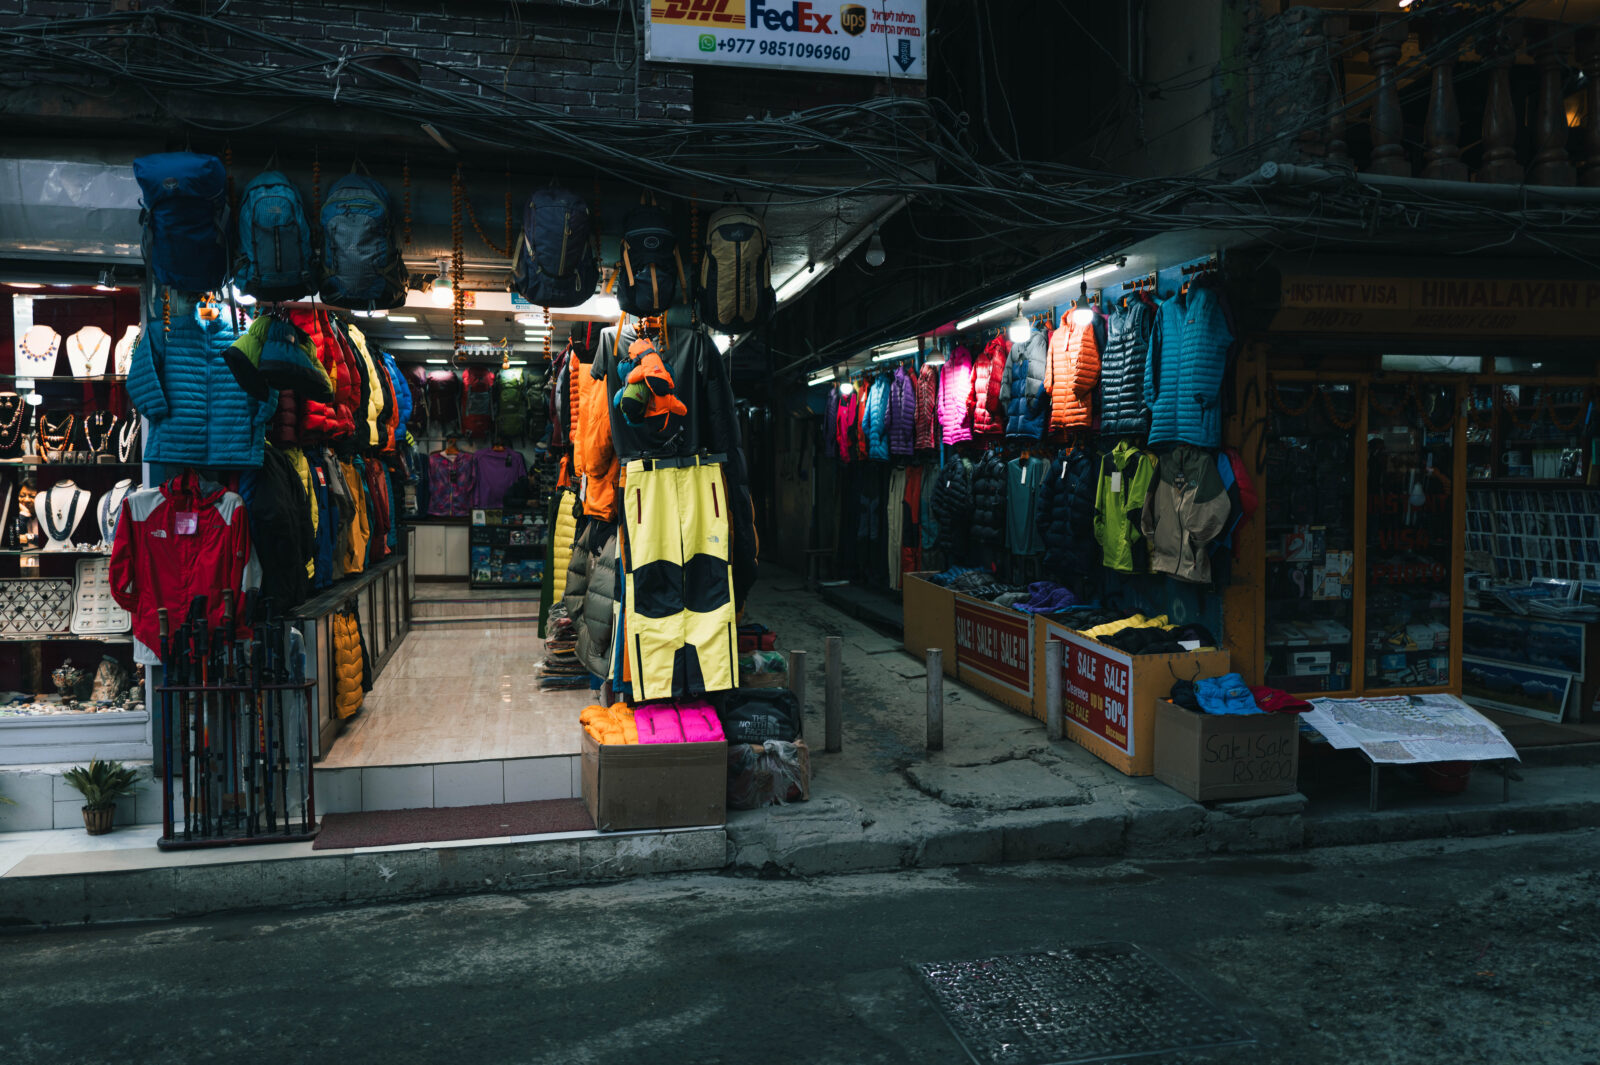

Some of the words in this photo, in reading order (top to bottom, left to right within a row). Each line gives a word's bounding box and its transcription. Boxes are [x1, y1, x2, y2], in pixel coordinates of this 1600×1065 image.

[664, 0, 733, 23] DHL
[842, 14, 865, 31] ups
[717, 37, 755, 54] +977
[759, 40, 851, 61] 9851096960
[1289, 282, 1356, 302] INSTANT
[1360, 284, 1398, 304] VISA
[1421, 280, 1578, 308] HIMALAYAN
[1303, 311, 1364, 328] PHOTO
[1378, 528, 1429, 551] VISA
[1371, 562, 1445, 584] PHOTO
[1077, 650, 1096, 682] SALE
[1104, 663, 1127, 696] SALE
[752, 714, 768, 722] THE
[1075, 703, 1089, 724] SALE
[1105, 695, 1126, 728] 50%
